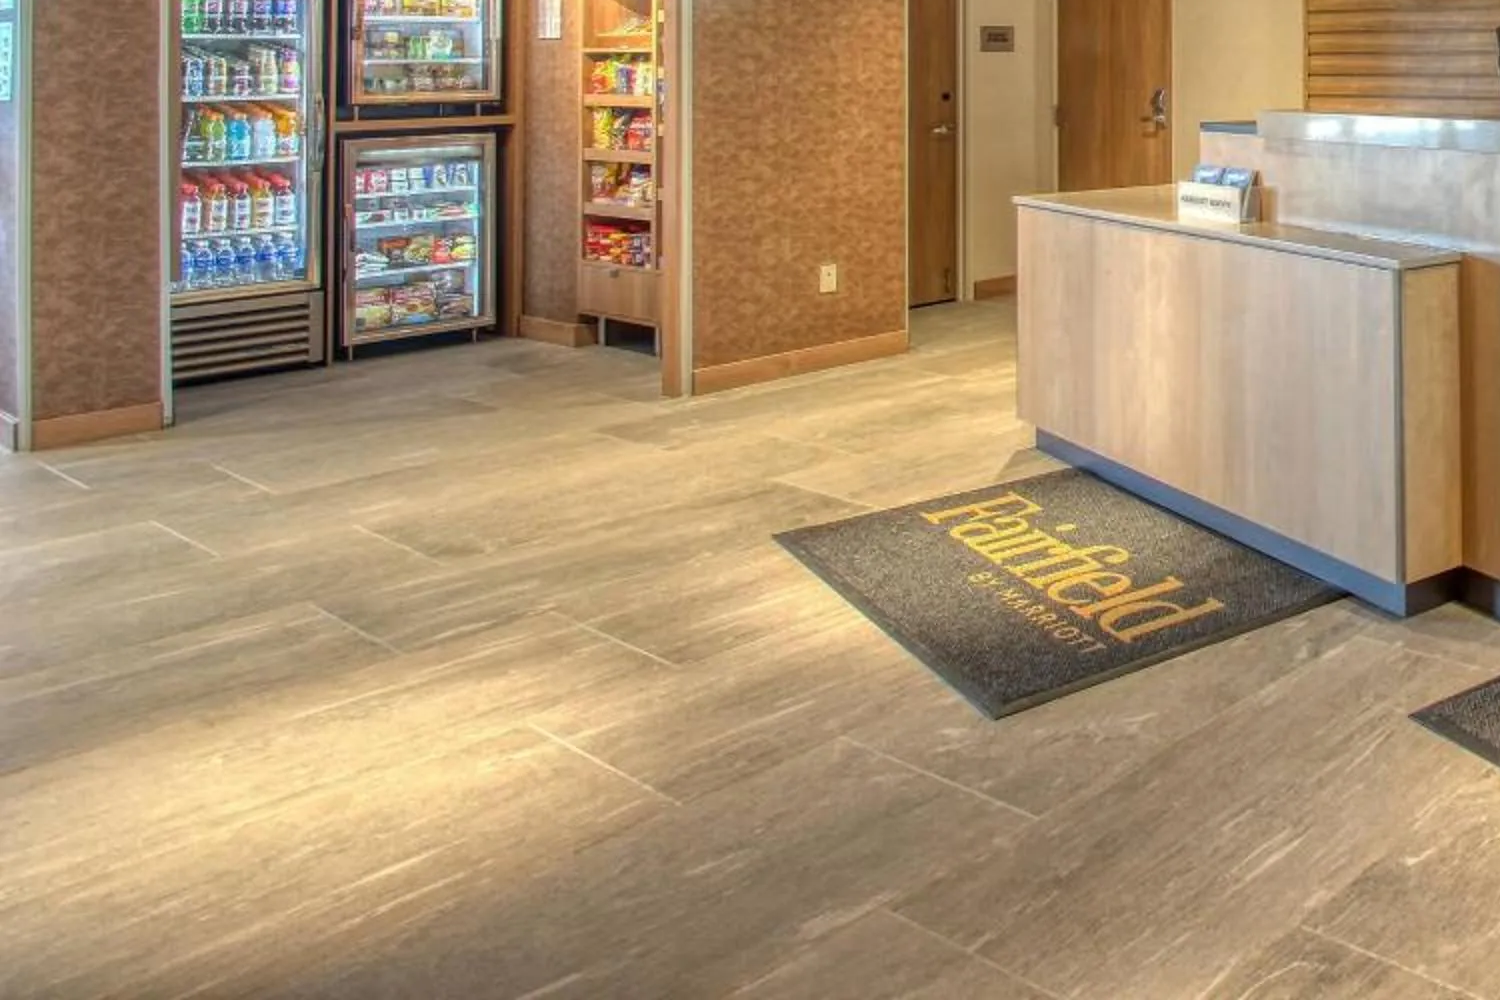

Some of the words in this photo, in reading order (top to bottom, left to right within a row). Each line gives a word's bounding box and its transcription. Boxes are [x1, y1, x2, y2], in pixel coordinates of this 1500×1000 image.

[920, 491, 1225, 644] Fairfield
[967, 571, 1002, 592] BY
[1000, 587, 1106, 653] MARRIOTT
